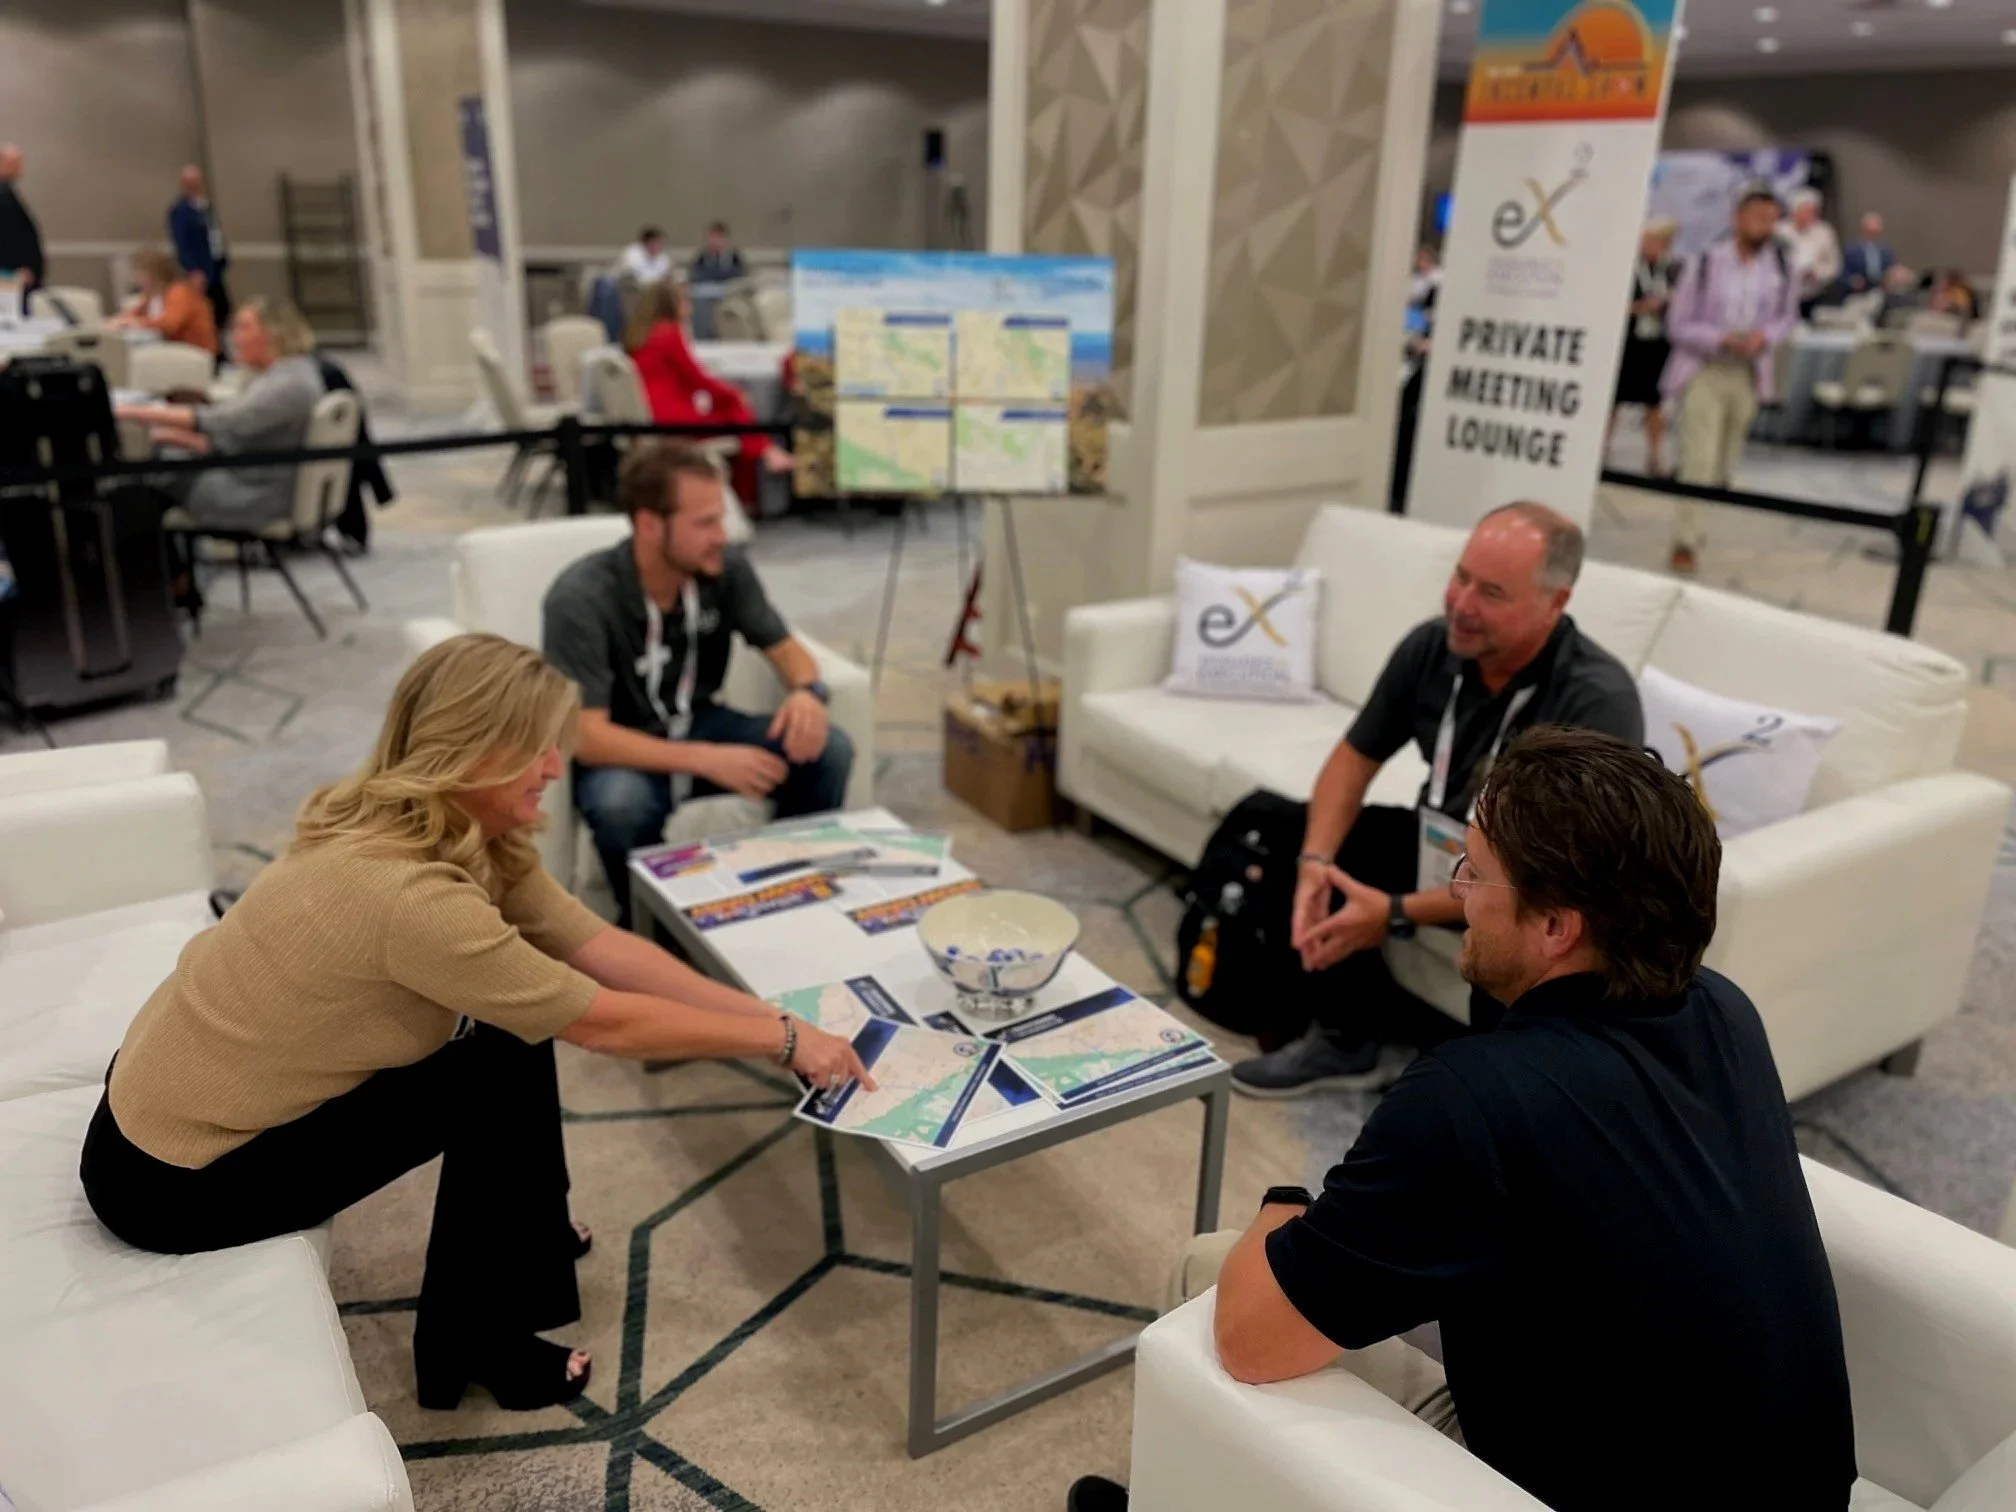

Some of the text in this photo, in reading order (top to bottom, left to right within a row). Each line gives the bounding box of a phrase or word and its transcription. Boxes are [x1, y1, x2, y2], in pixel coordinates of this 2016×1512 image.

[1459, 317, 1586, 365] PRIVATE
[1447, 365, 1580, 418] MEETING
[1446, 415, 1566, 467] LOUNGE
